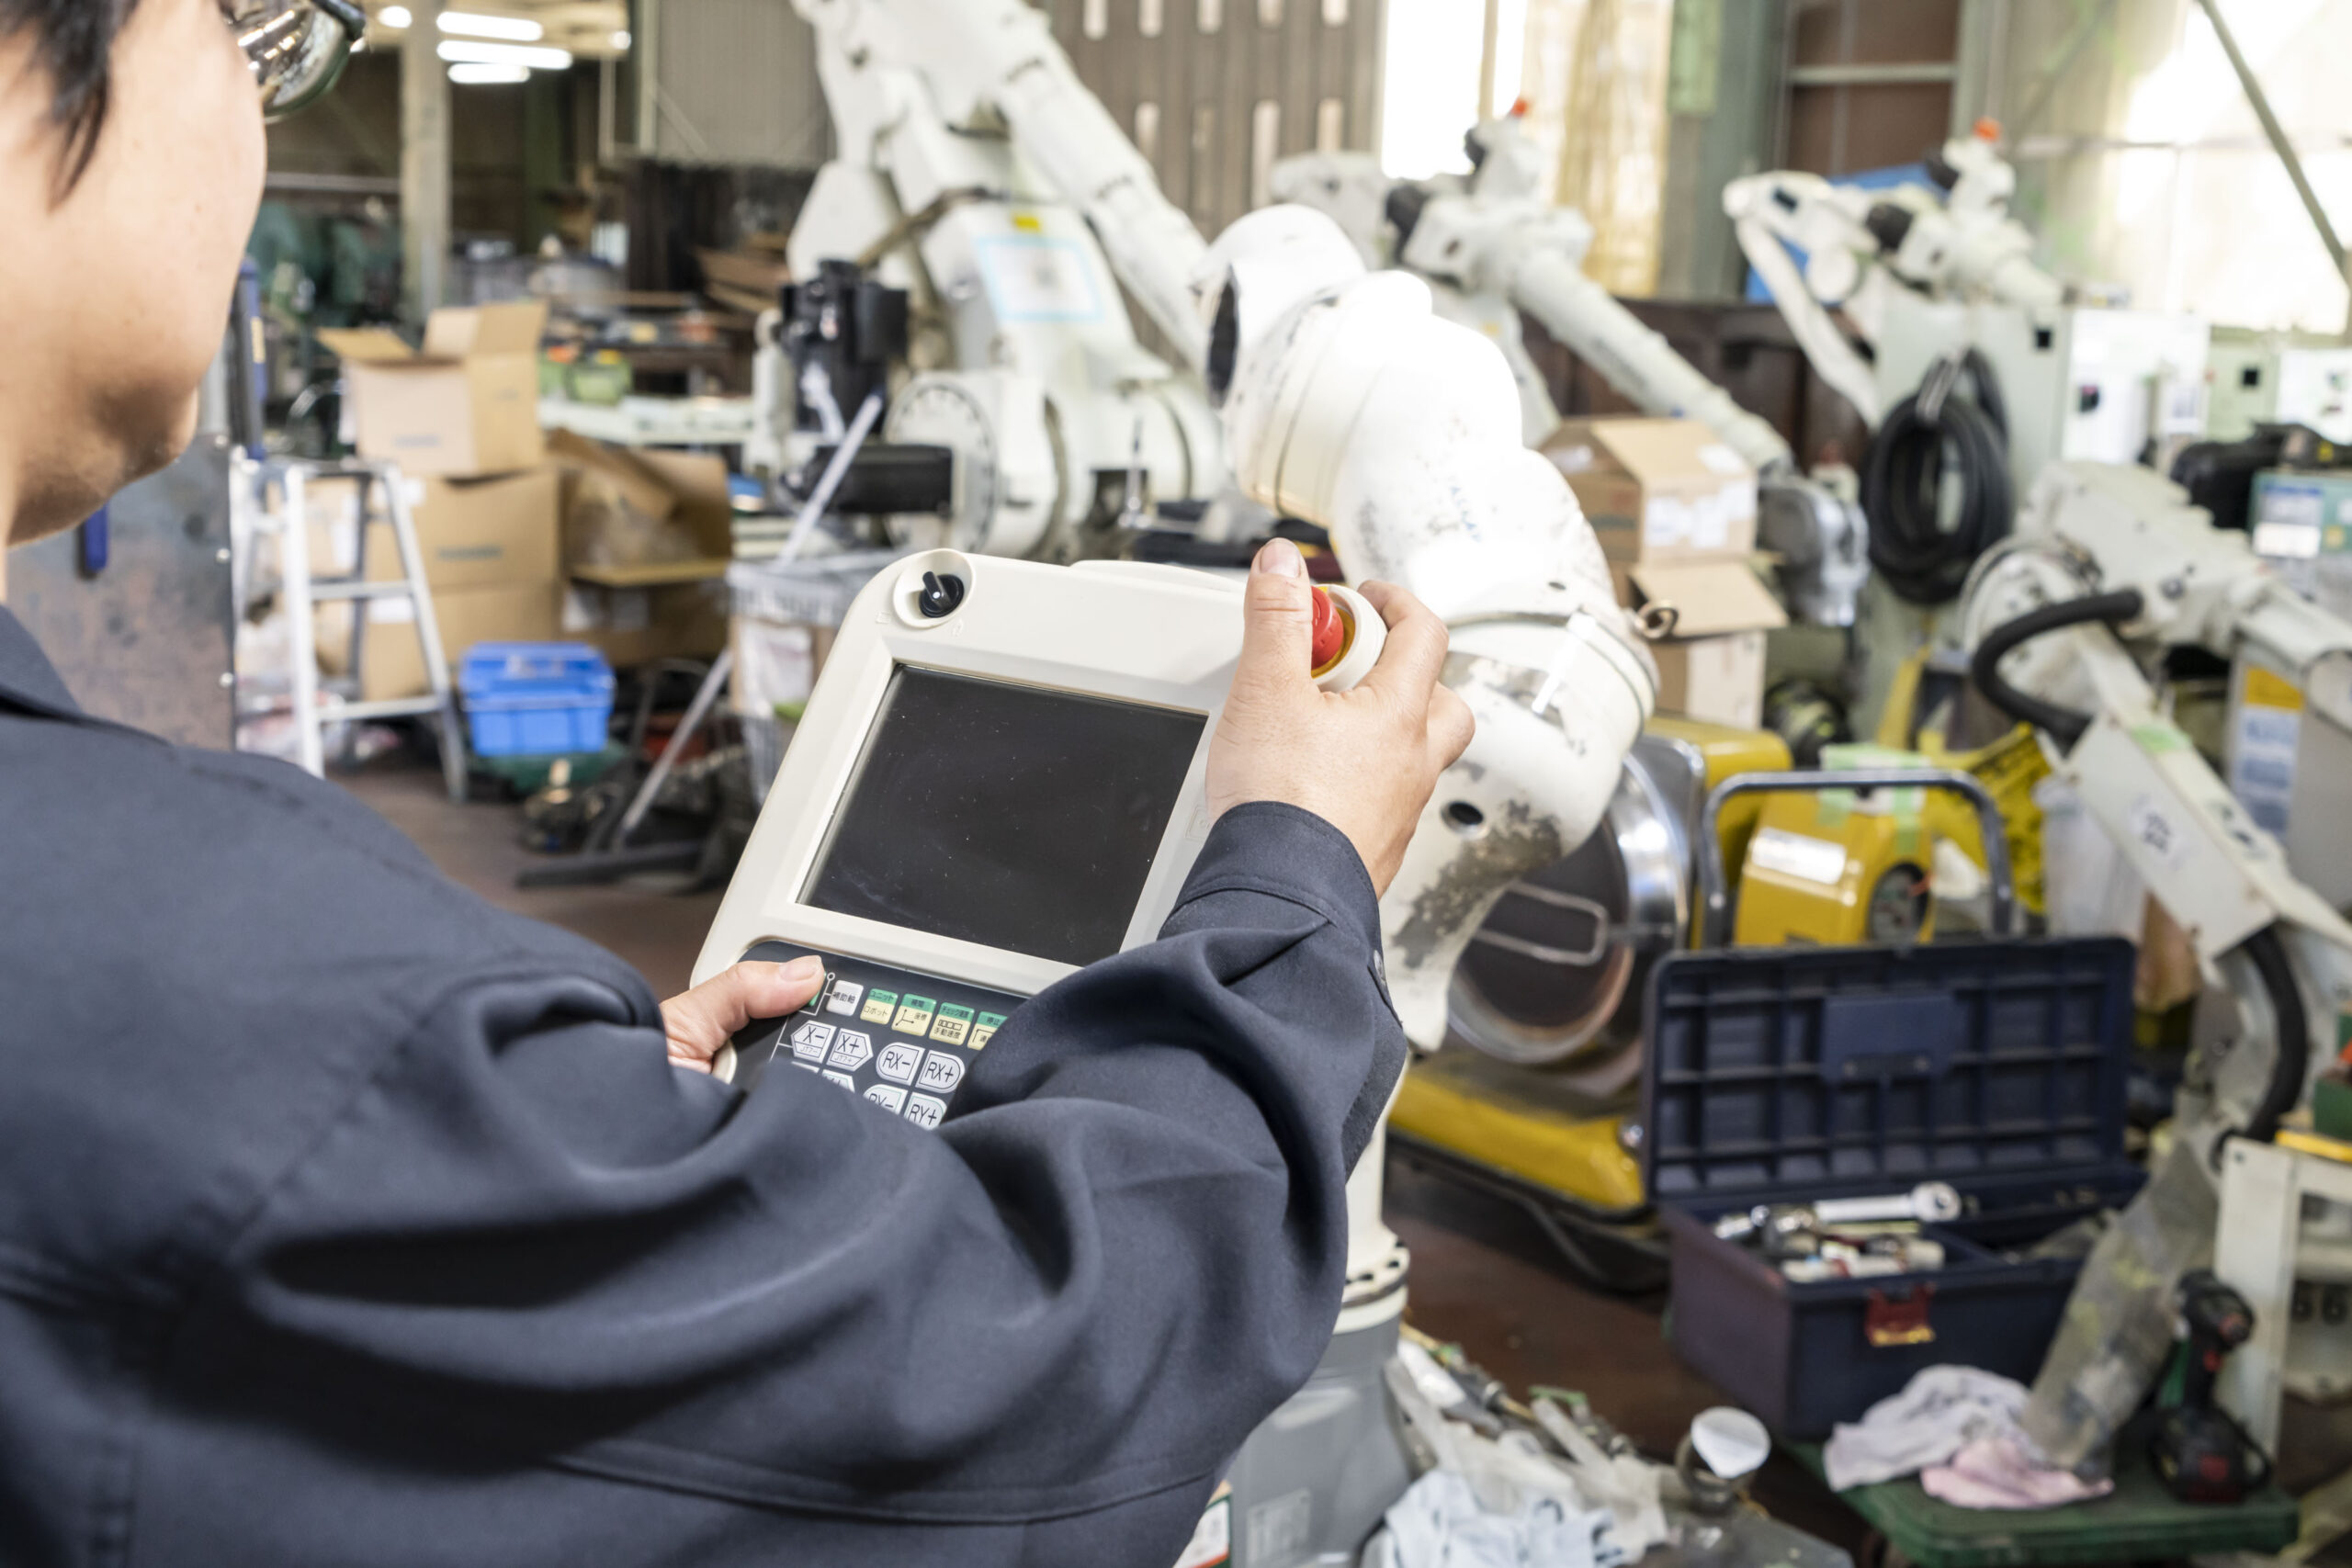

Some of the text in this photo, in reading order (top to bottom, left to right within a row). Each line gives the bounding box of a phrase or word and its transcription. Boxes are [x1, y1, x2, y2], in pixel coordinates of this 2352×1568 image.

[870, 990, 895, 1002] ユニット
[864, 1005, 888, 1018] ロボット
[802, 1025, 825, 1043] X-
[933, 1027, 962, 1040] 手動速度
[837, 1034, 860, 1054] X+
[882, 1051, 910, 1070] RX-
[924, 1061, 954, 1083] RX+
[907, 1103, 937, 1125] RY+
